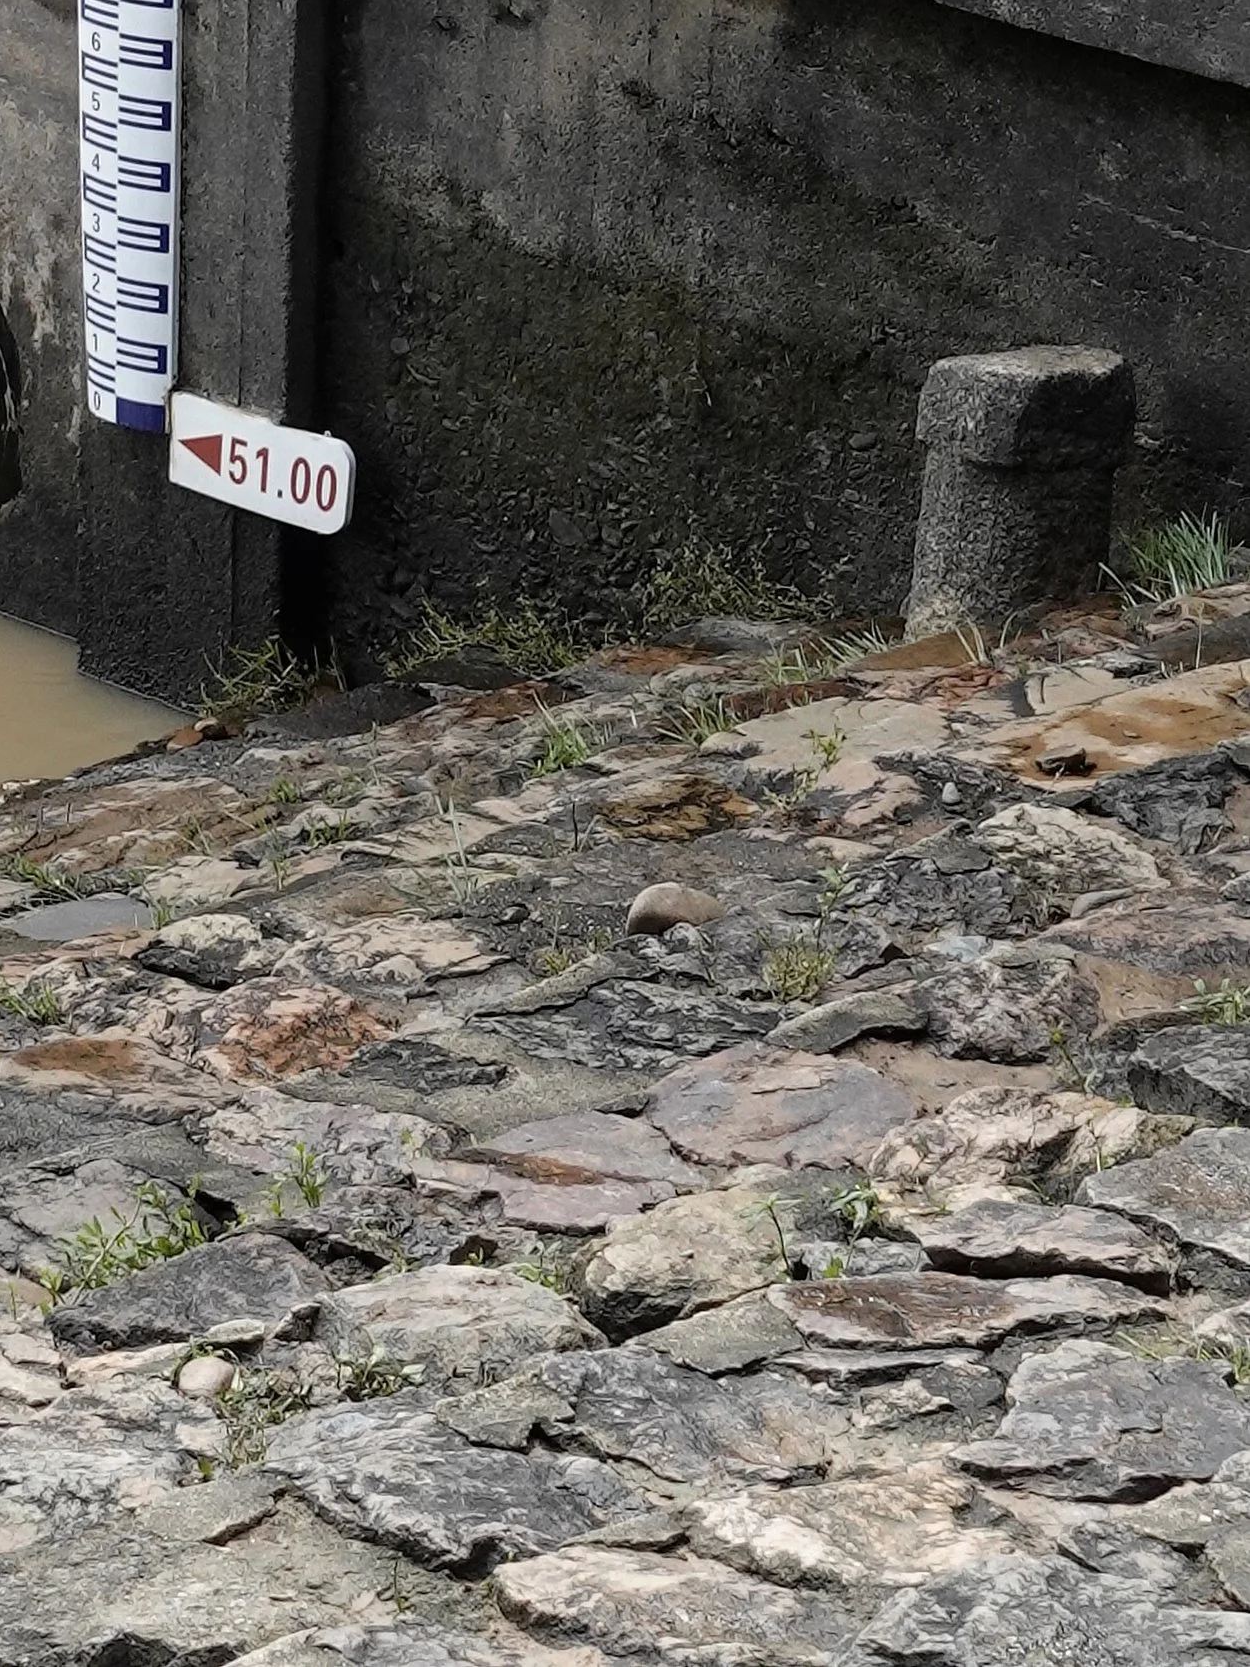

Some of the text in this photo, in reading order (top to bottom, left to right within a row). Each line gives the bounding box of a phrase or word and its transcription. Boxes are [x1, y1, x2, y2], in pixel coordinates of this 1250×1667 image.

[91, 32, 101, 51] 6
[91, 91, 100, 111] 5
[91, 153, 100, 172] 4
[92, 213, 100, 232] 3
[92, 273, 100, 293] 2
[92, 333, 98, 352] 1
[93, 391, 100, 411] 0
[229, 436, 337, 513] 51.00
